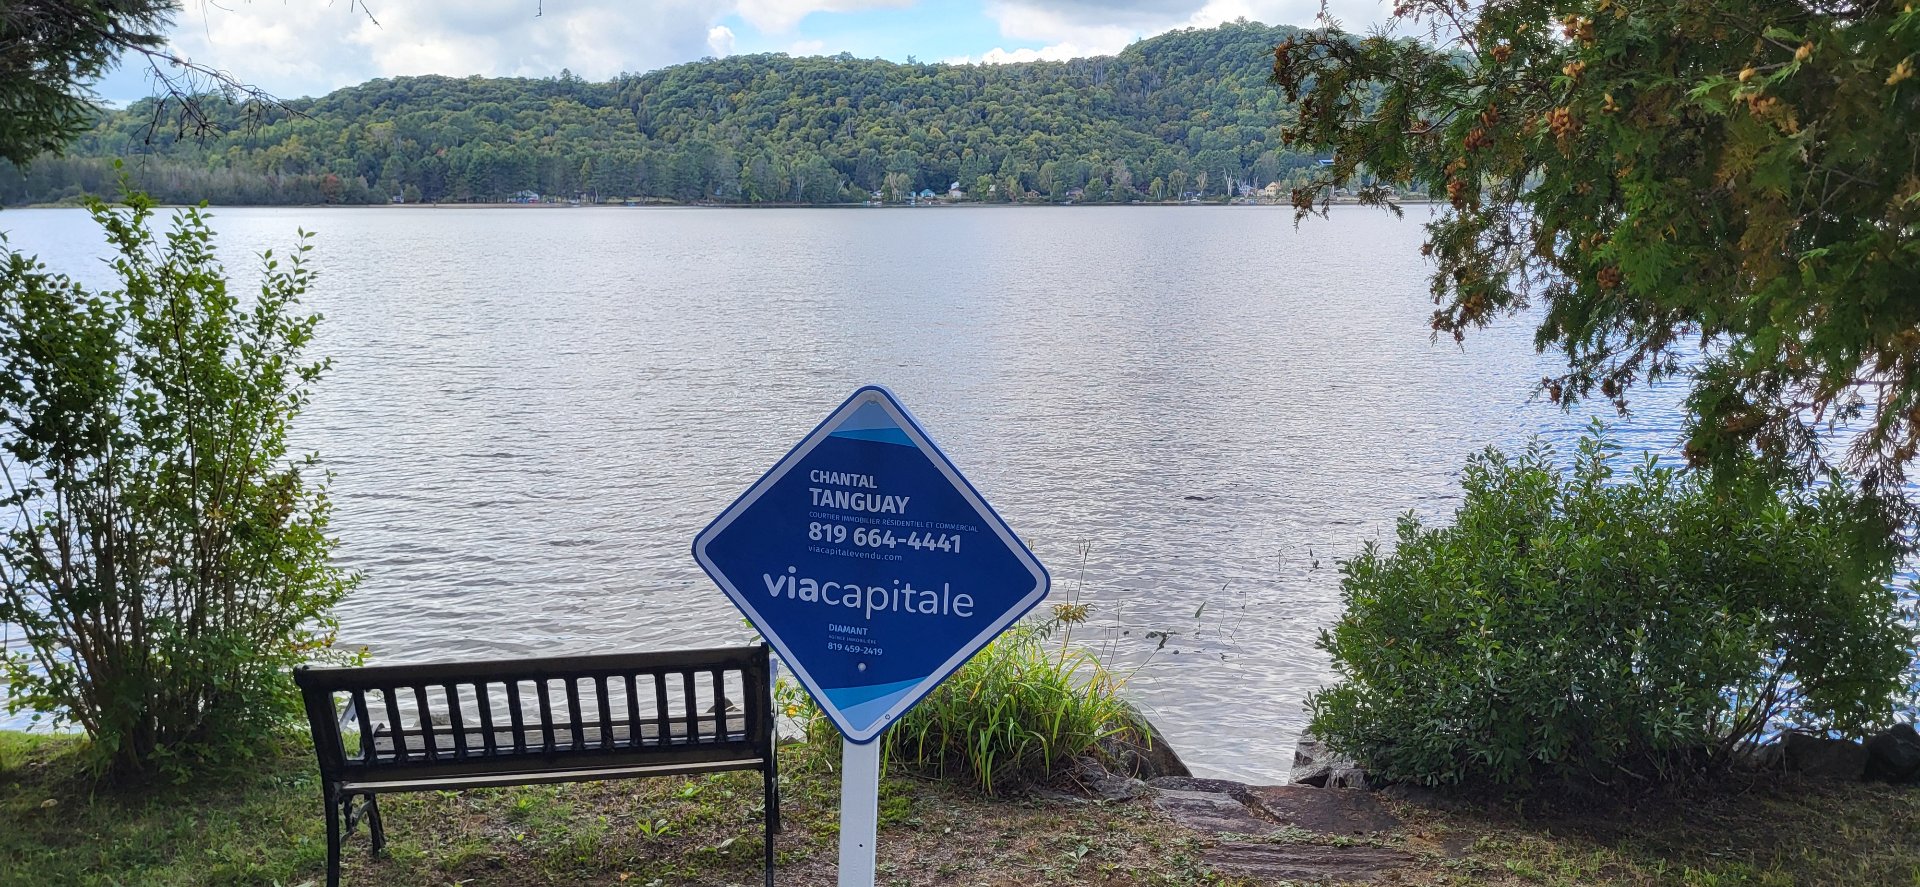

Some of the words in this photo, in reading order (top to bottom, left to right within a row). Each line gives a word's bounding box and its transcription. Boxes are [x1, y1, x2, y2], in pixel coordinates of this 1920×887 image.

[810, 469, 878, 489] CHANTAL
[809, 487, 910, 514] TANGUAY
[809, 511, 840, 521] COURTIER
[841, 515, 880, 525] IMMOBILIER
[882, 517, 924, 528] RÉSIDENTIEL
[935, 522, 979, 533] COMMERCIAL
[808, 521, 847, 544] 819
[853, 527, 961, 553] 664-4441
[808, 545, 903, 561] viacapitalevendu.com
[763, 565, 974, 619] viacapitale
[828, 623, 868, 636] DIAMANT
[827, 642, 843, 651] 819
[844, 644, 883, 656] 459-2419
